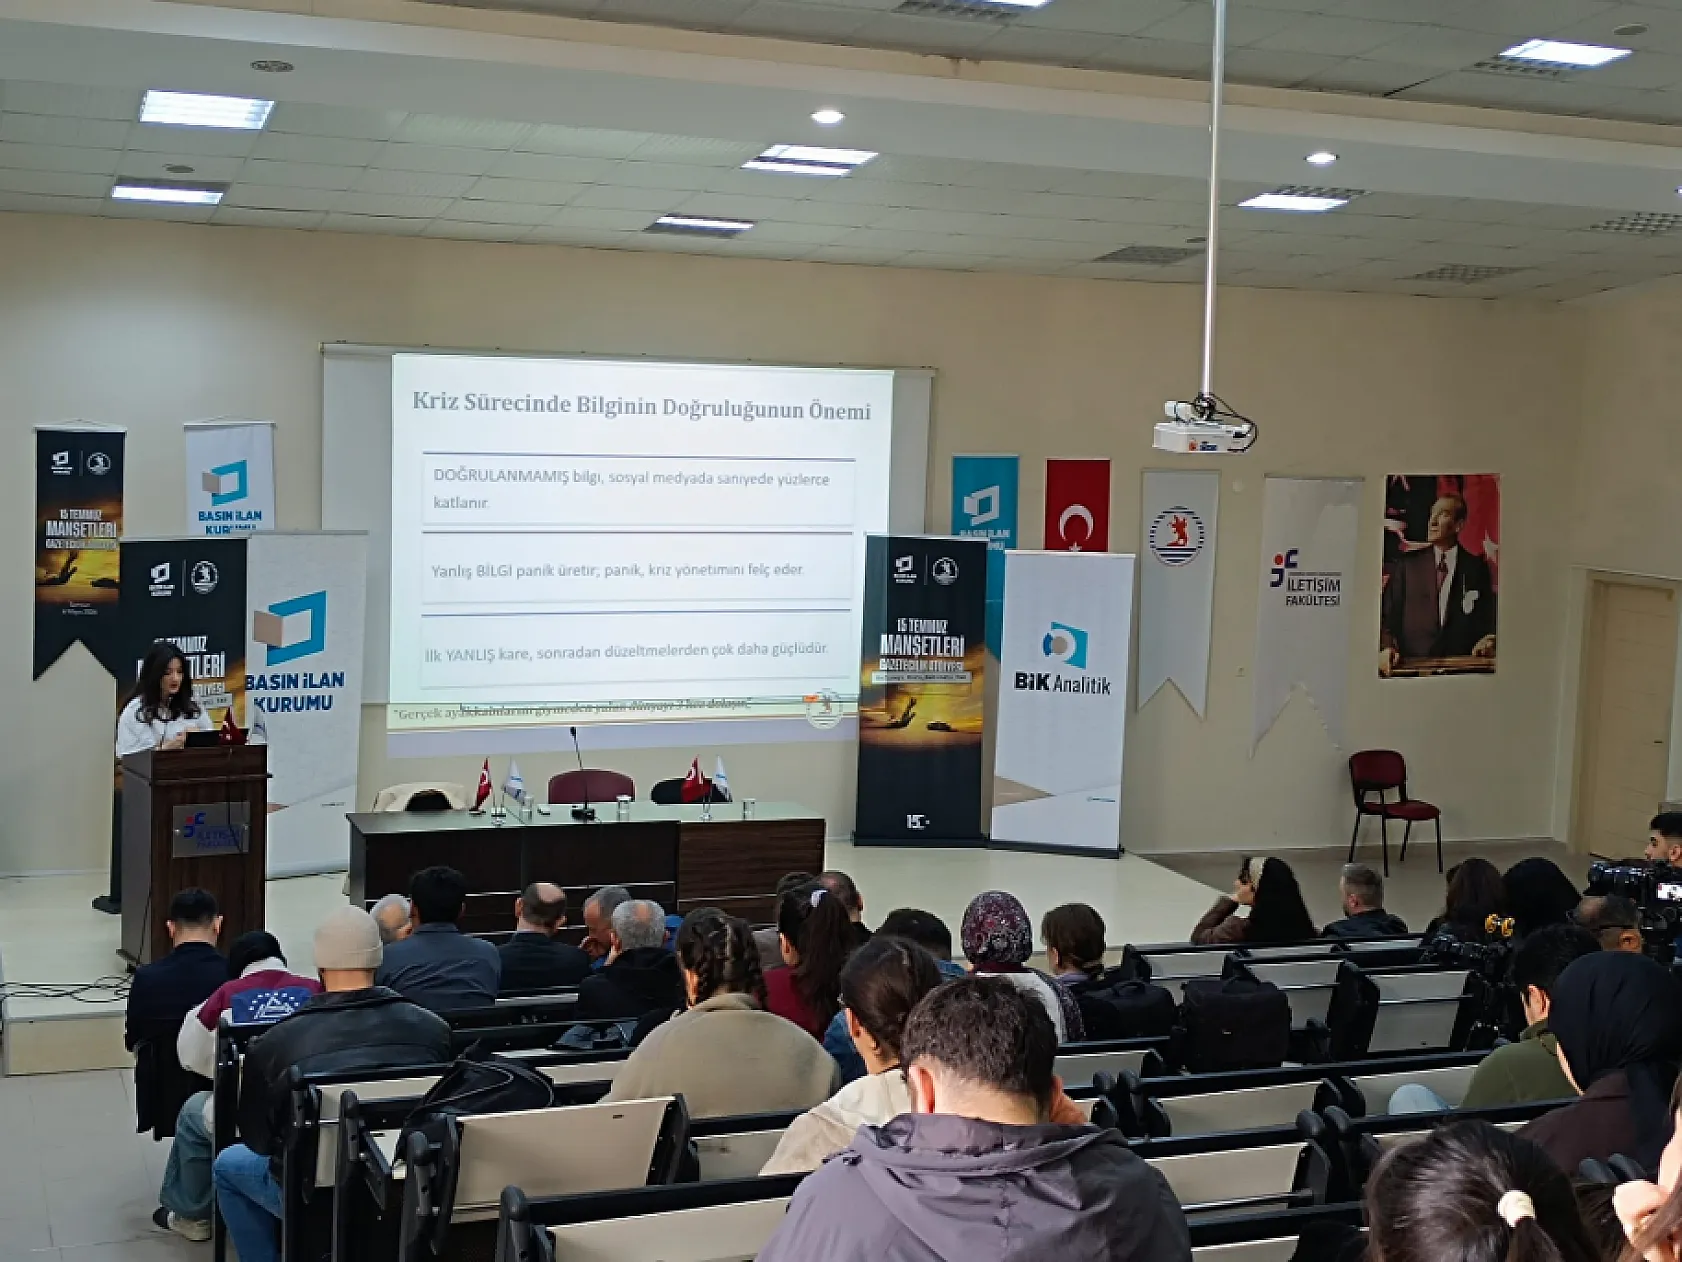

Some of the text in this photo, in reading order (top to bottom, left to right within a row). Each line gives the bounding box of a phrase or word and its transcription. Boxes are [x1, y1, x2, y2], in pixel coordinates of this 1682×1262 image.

[413, 391, 872, 421] Kriz Sürecinde Bilginin Doğruluğunun Önemi
[433, 465, 569, 485] DOĞRULANMAMIŞ
[608, 471, 649, 485] sosyal
[653, 472, 713, 486] medyada
[199, 510, 233, 521] BASIN
[432, 564, 472, 580] Yanlış
[517, 562, 555, 580] panik
[446, 648, 496, 664] YANLIŞ
[500, 647, 533, 662] kare,
[536, 646, 601, 660] sonradan
[604, 644, 709, 659] düzeltmelerden
[711, 642, 734, 658] çok
[738, 641, 769, 656] daha
[245, 674, 299, 690] BASIN
[1053, 675, 1111, 695] Analitik
[254, 695, 333, 712] KURUMU
